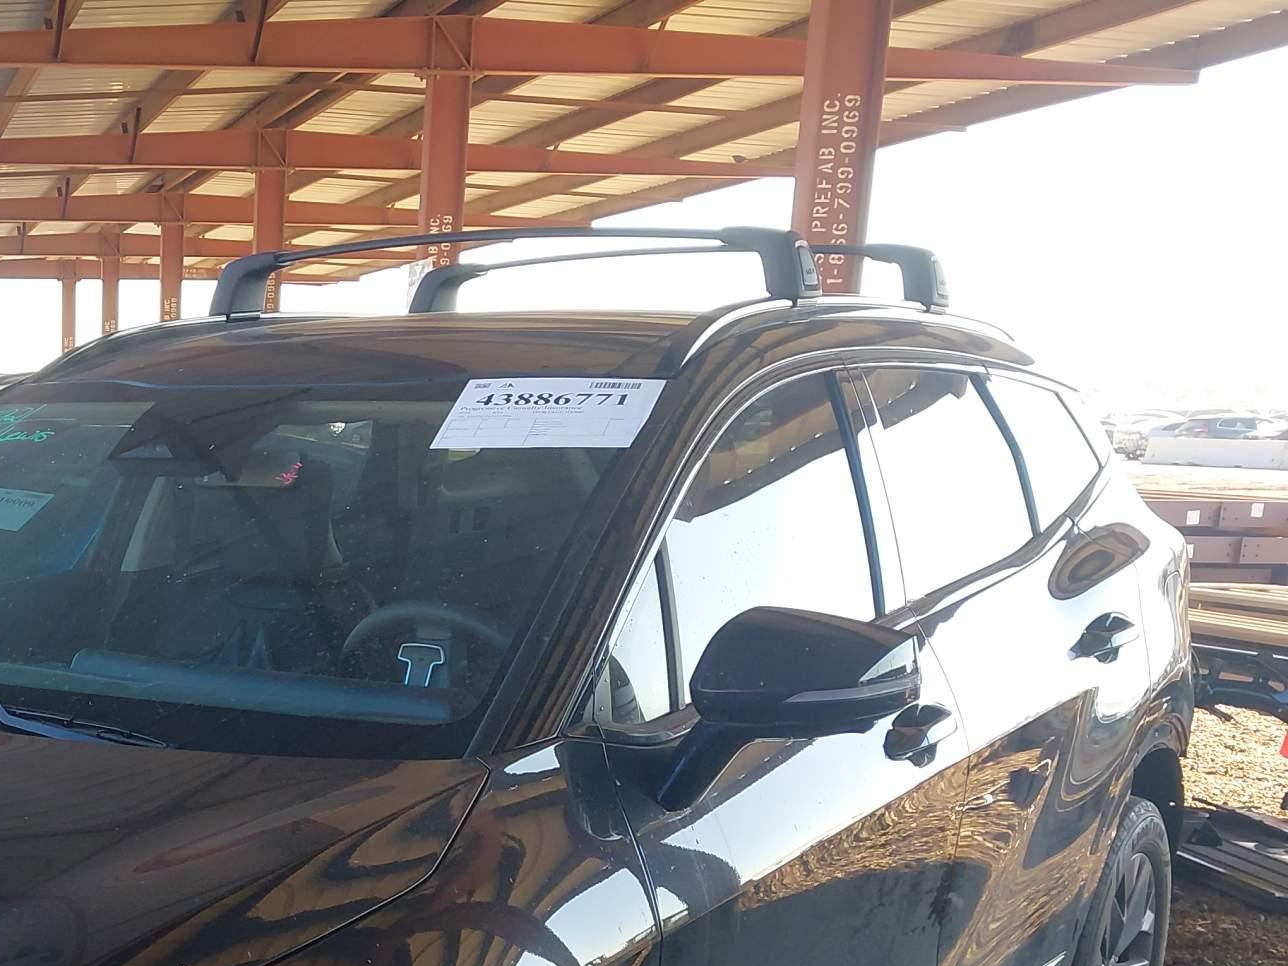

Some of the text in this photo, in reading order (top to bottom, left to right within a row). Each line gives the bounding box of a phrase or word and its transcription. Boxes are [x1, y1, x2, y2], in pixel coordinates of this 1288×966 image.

[821, 92, 841, 134] INC.
[811, 147, 835, 232] PREFAB
[476, 393, 628, 406] 43886771
